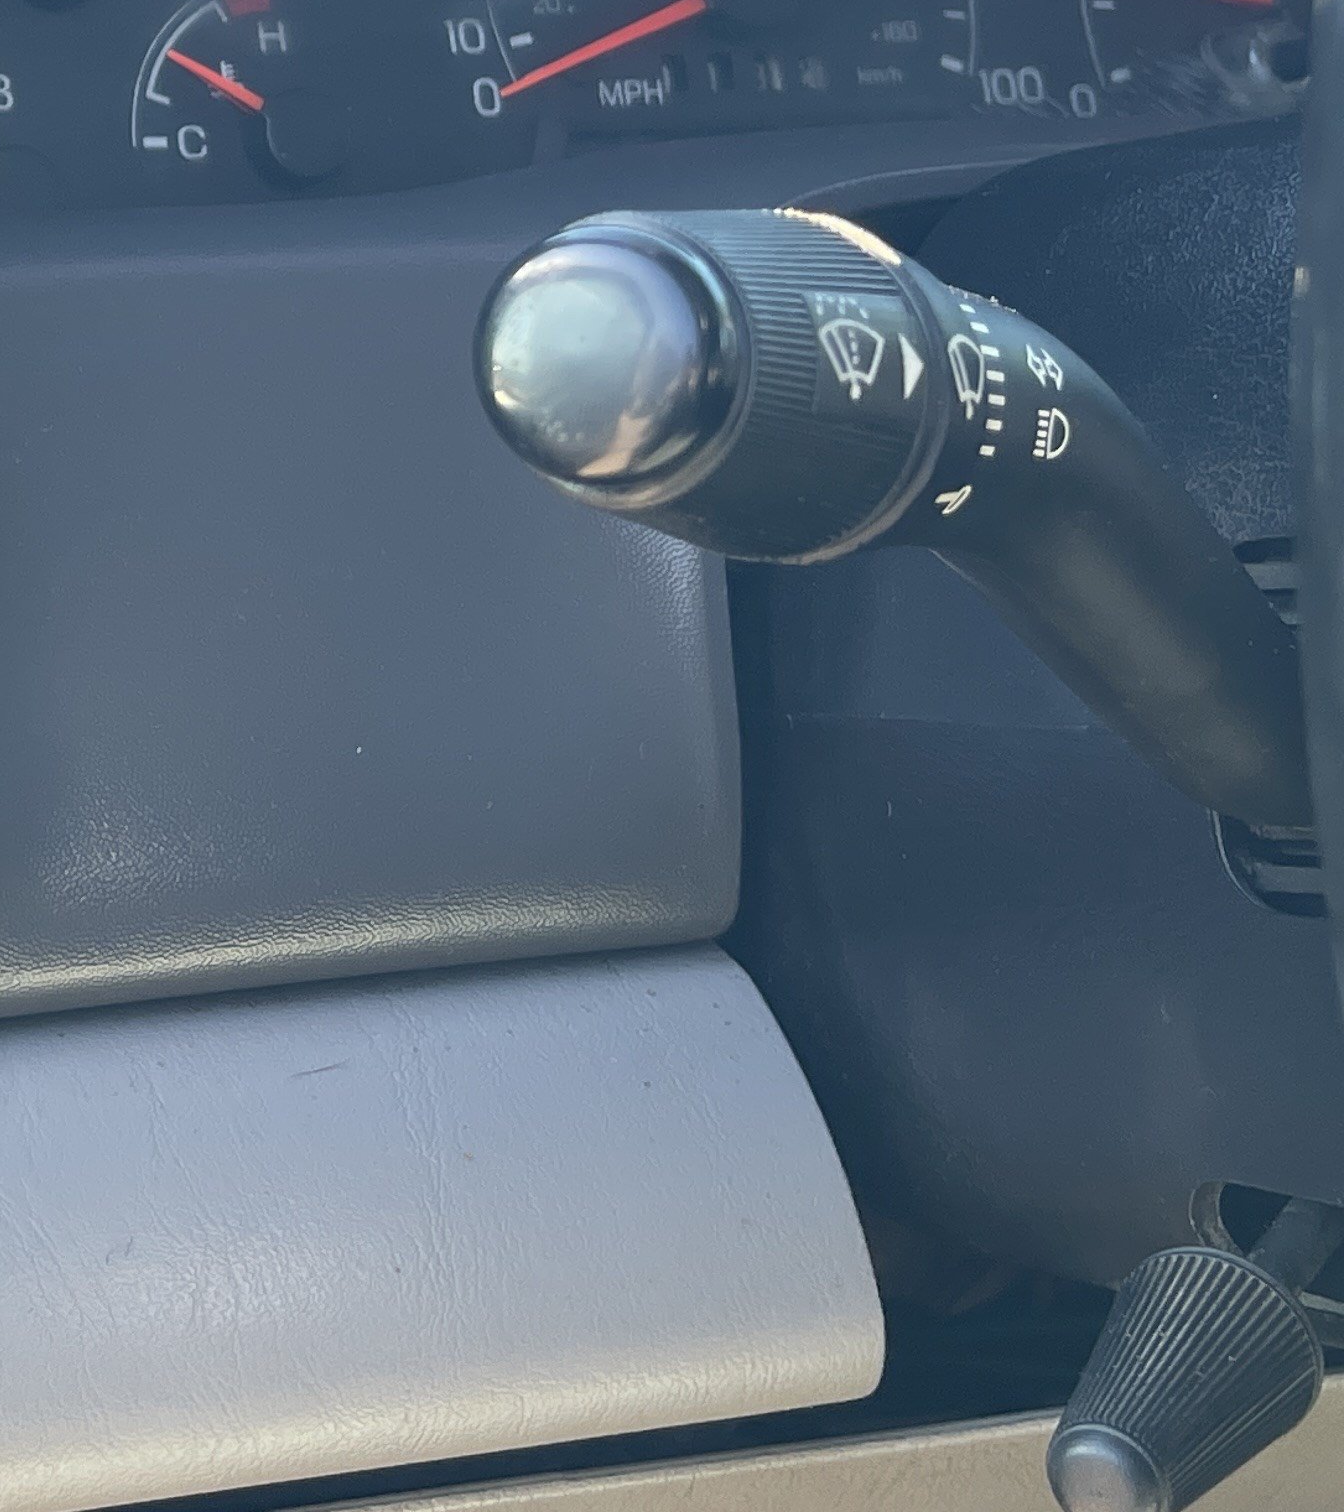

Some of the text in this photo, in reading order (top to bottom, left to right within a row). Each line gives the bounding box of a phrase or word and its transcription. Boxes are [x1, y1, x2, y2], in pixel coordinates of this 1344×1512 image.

[257, 19, 288, 53] H
[444, 18, 485, 54] 10
[472, 78, 501, 117] 0
[597, 78, 663, 107] MPH
[978, 67, 1044, 105] 100
[1068, 83, 1098, 119] 0
[177, 124, 208, 160] C
